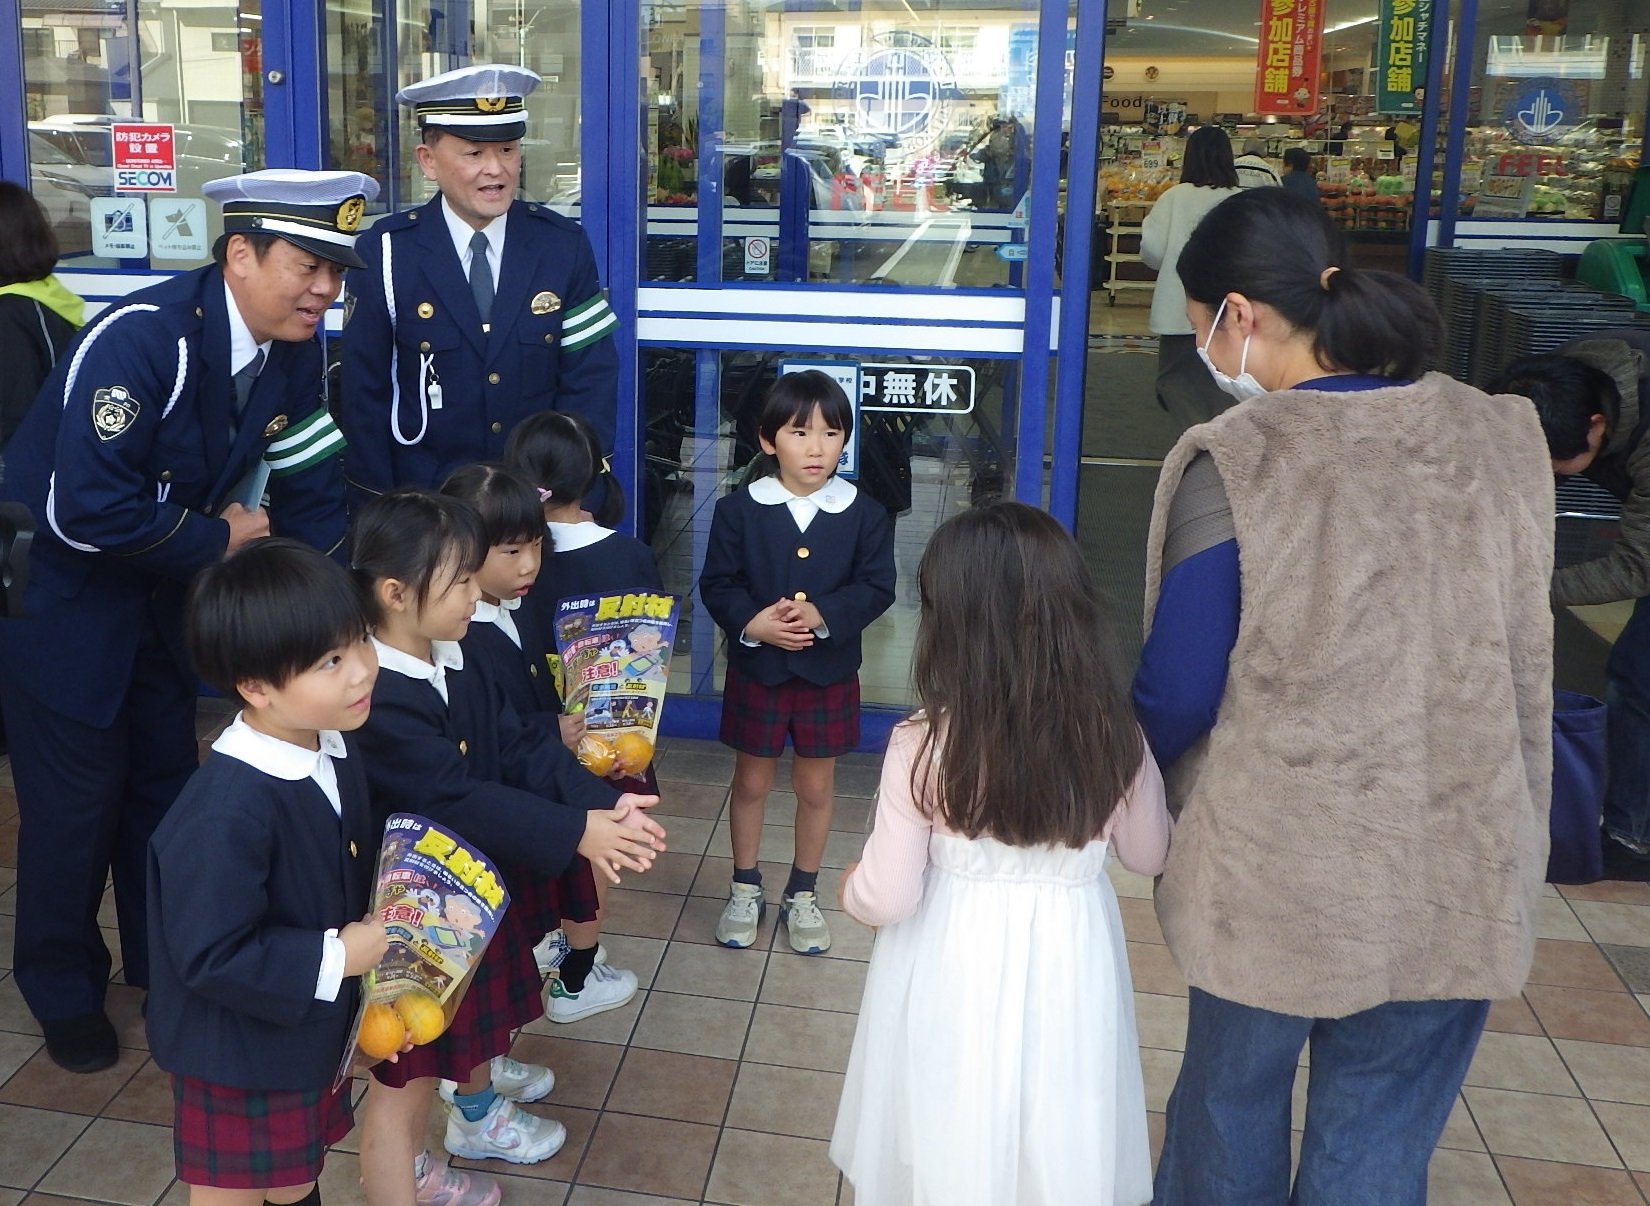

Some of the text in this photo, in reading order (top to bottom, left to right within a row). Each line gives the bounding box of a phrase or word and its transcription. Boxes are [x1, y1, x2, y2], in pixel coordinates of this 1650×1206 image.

[1416, 0, 1432, 63] シャチマネー
[1263, 0, 1295, 93] 参加店舗
[1386, 0, 1416, 92] 参加店舗
[115, 132, 171, 142] 防犯カメラ
[129, 143, 158, 154] 設置
[1496, 154, 1569, 177] FEEL
[118, 171, 172, 186] SECOM
